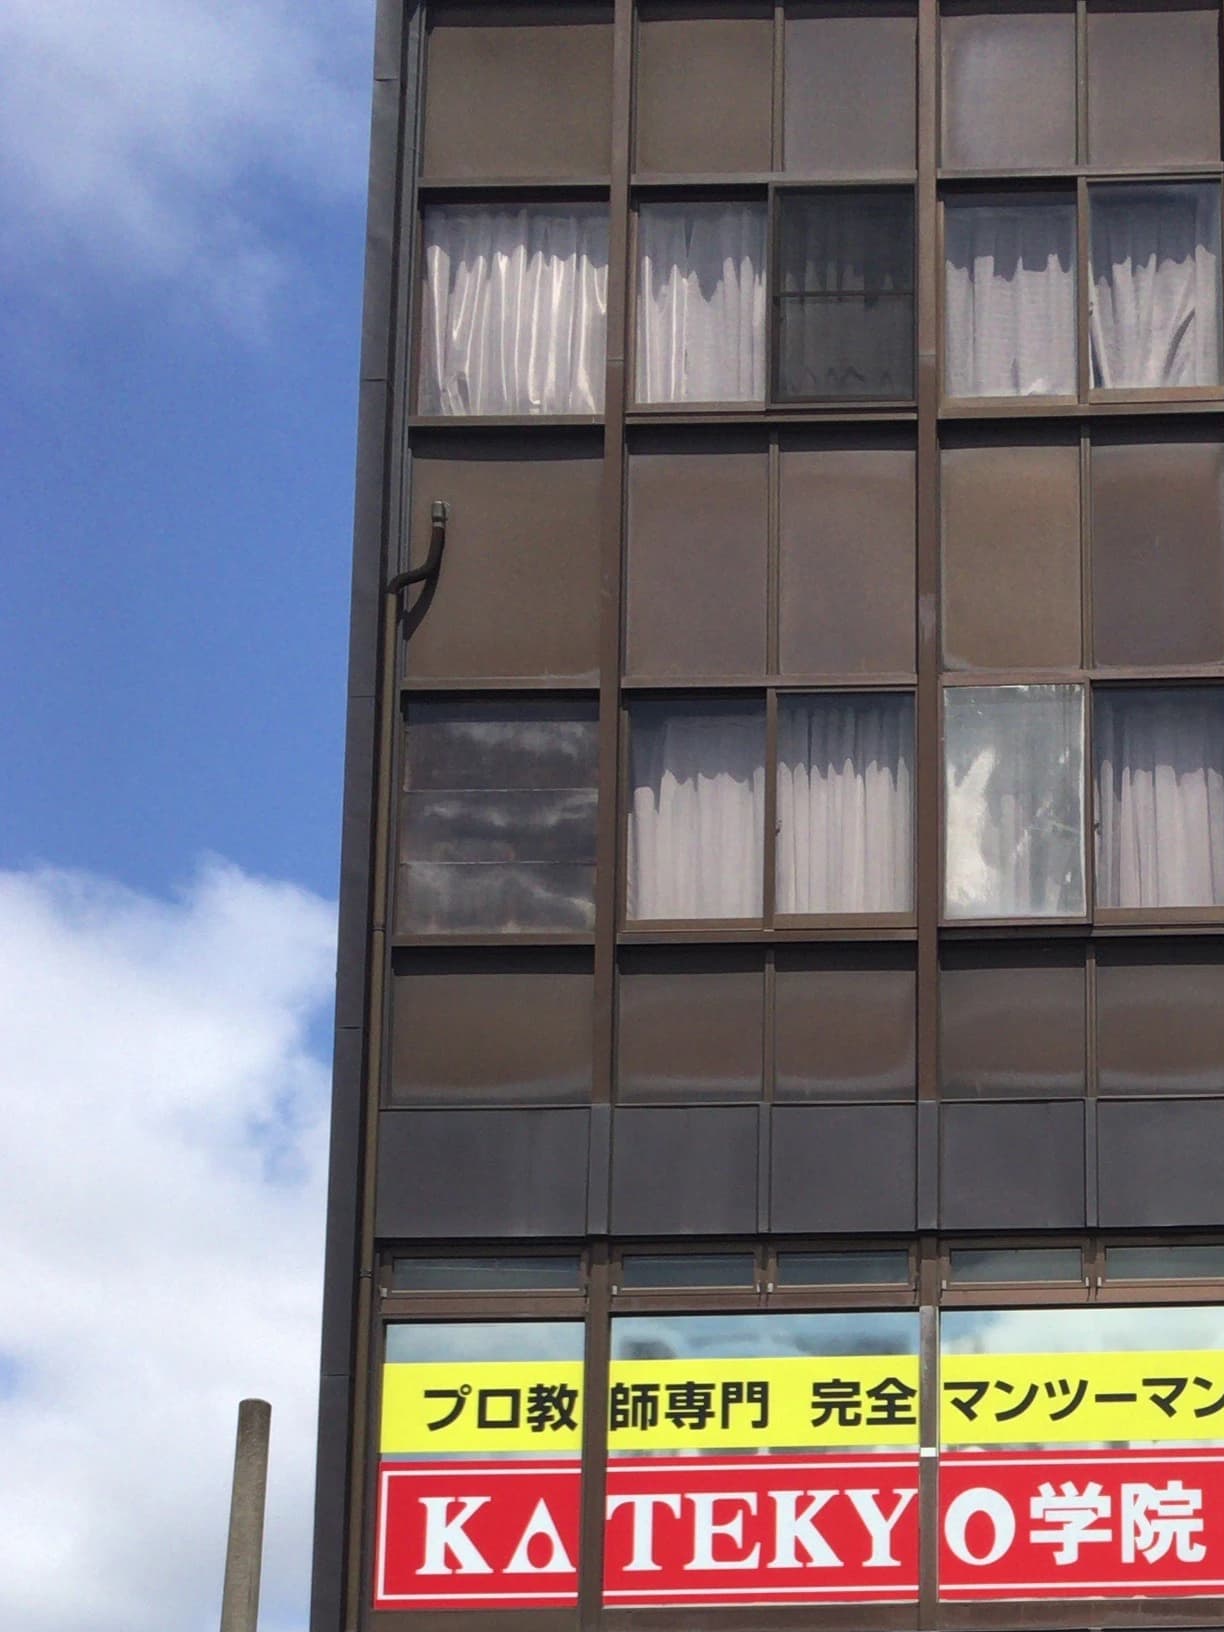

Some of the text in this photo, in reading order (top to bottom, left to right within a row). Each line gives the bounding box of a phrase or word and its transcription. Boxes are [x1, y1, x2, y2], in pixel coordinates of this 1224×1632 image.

[423, 1381, 769, 1432] プロ教師専門
[415, 1480, 1207, 1576] KATEKYO学院
